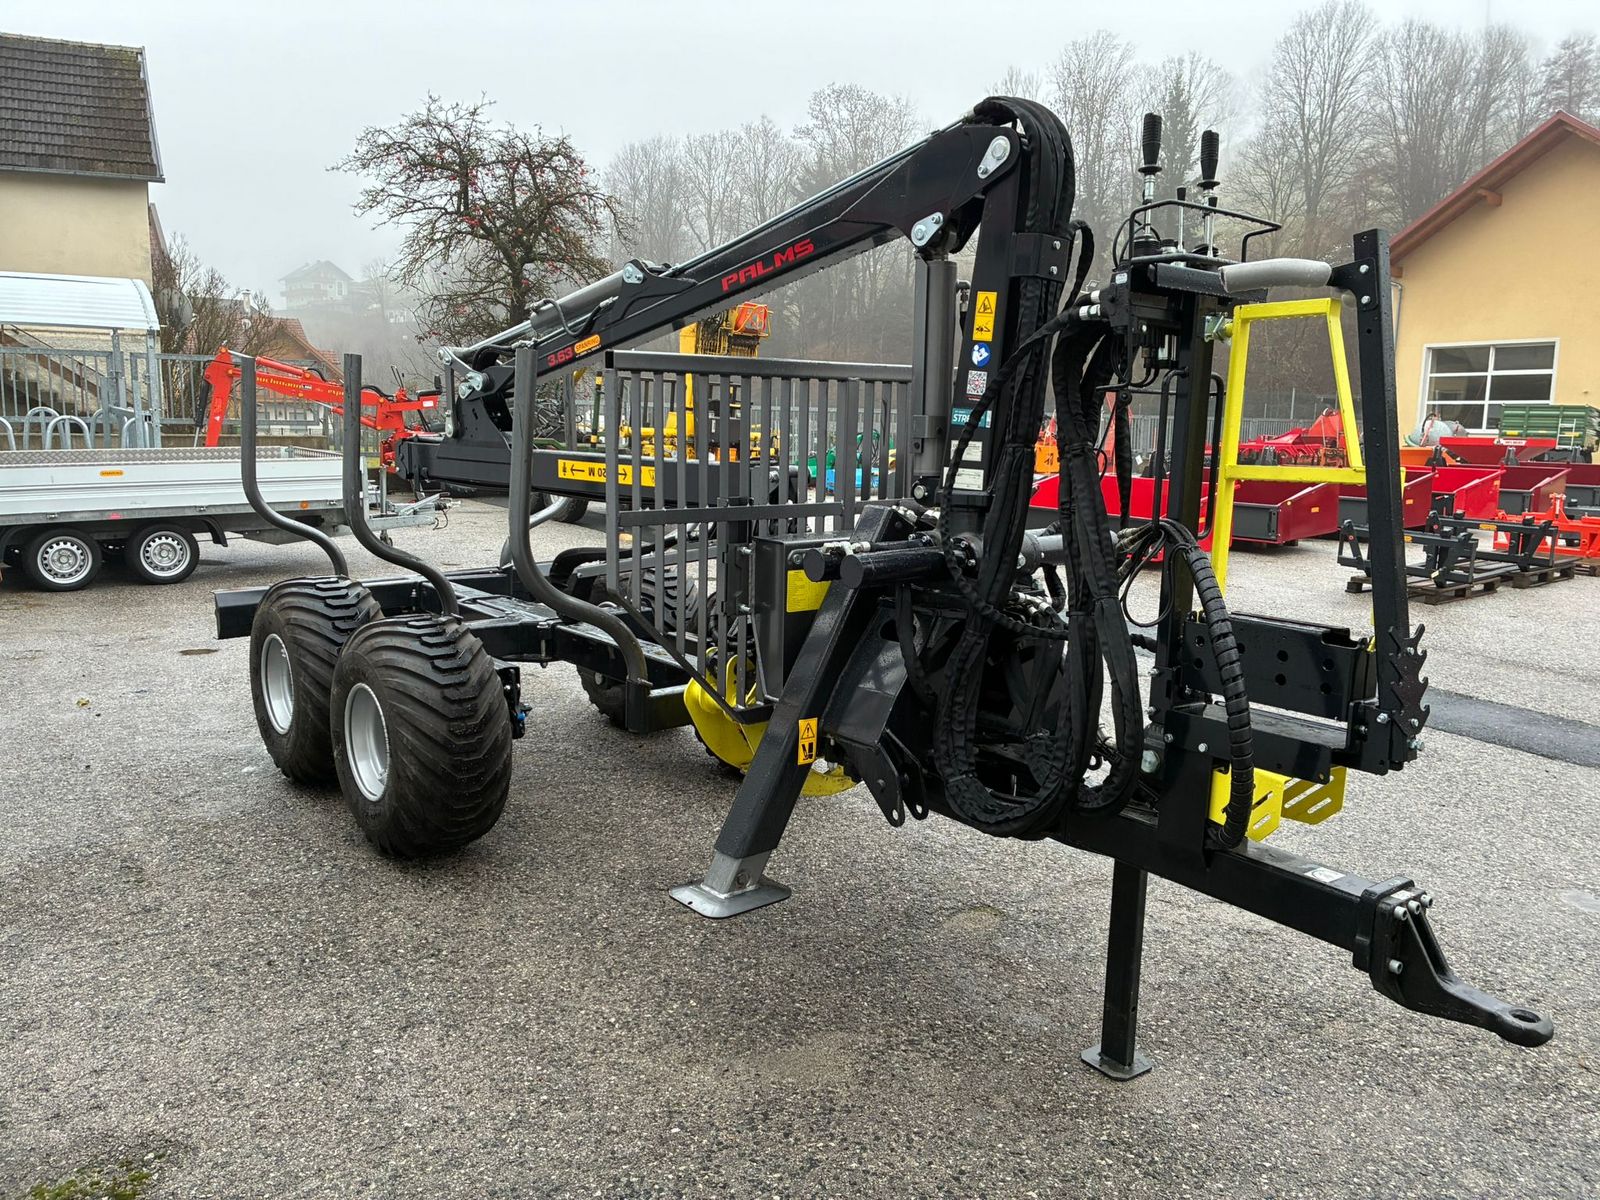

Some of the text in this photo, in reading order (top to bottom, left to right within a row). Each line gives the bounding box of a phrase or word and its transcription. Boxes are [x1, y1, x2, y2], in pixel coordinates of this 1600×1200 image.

[721, 239, 815, 292] PALMS
[547, 347, 574, 368] 3.63
[588, 466, 596, 477] M
